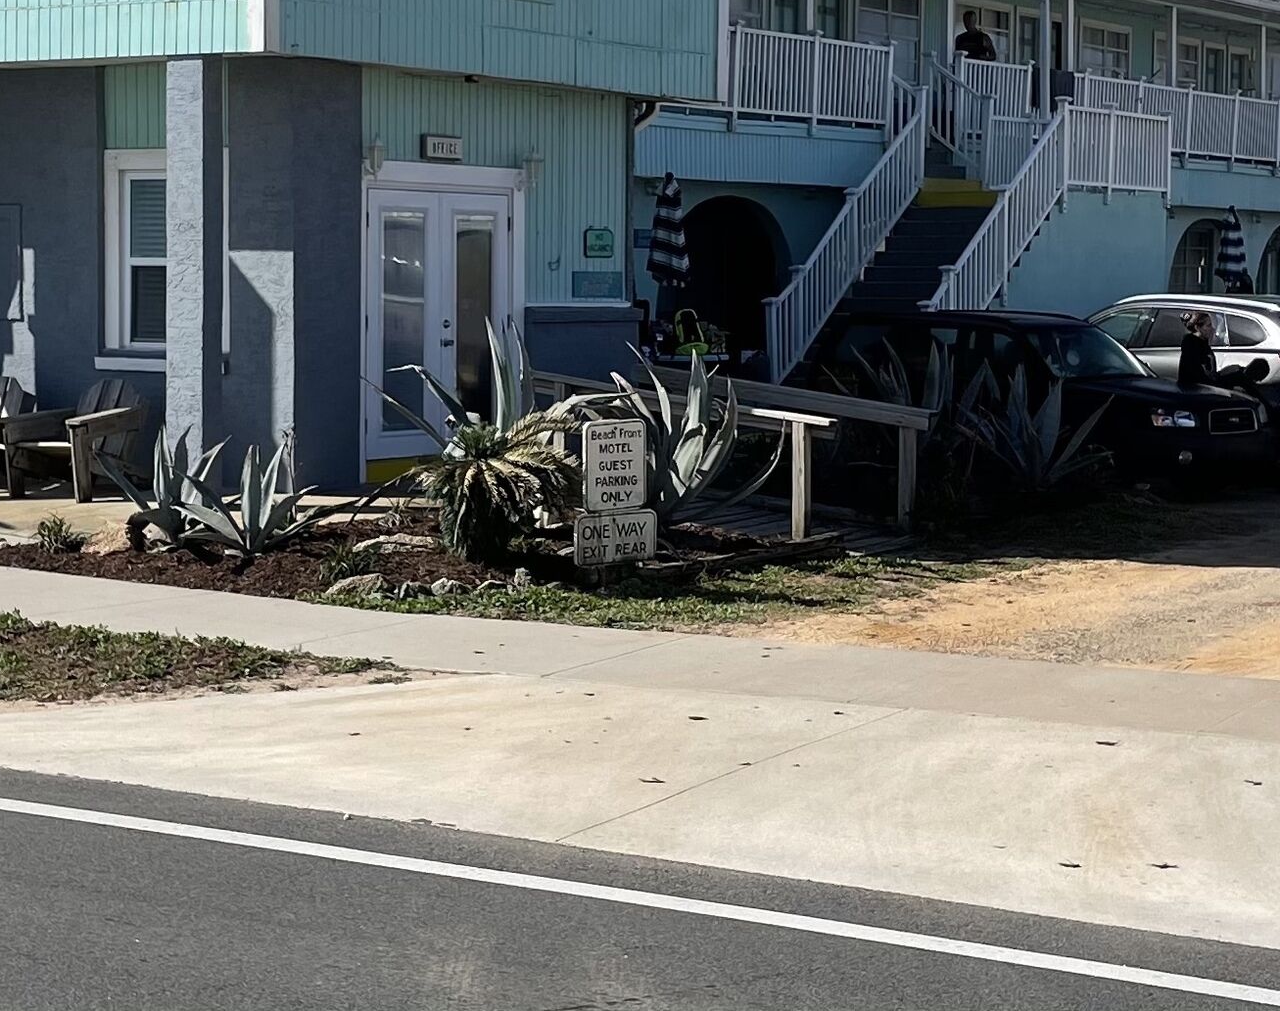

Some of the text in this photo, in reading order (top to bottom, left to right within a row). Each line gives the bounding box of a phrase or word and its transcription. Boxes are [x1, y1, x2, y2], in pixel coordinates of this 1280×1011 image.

[432, 141, 458, 155] OFFICE
[591, 428, 642, 441] Beach Front
[599, 443, 633, 454] MOTEL
[599, 460, 633, 471] GUEST
[595, 475, 638, 487] PARKING
[601, 491, 633, 503] ONLY
[582, 521, 647, 540] ONE WAY
[583, 541, 647, 559] EXIT REAR
